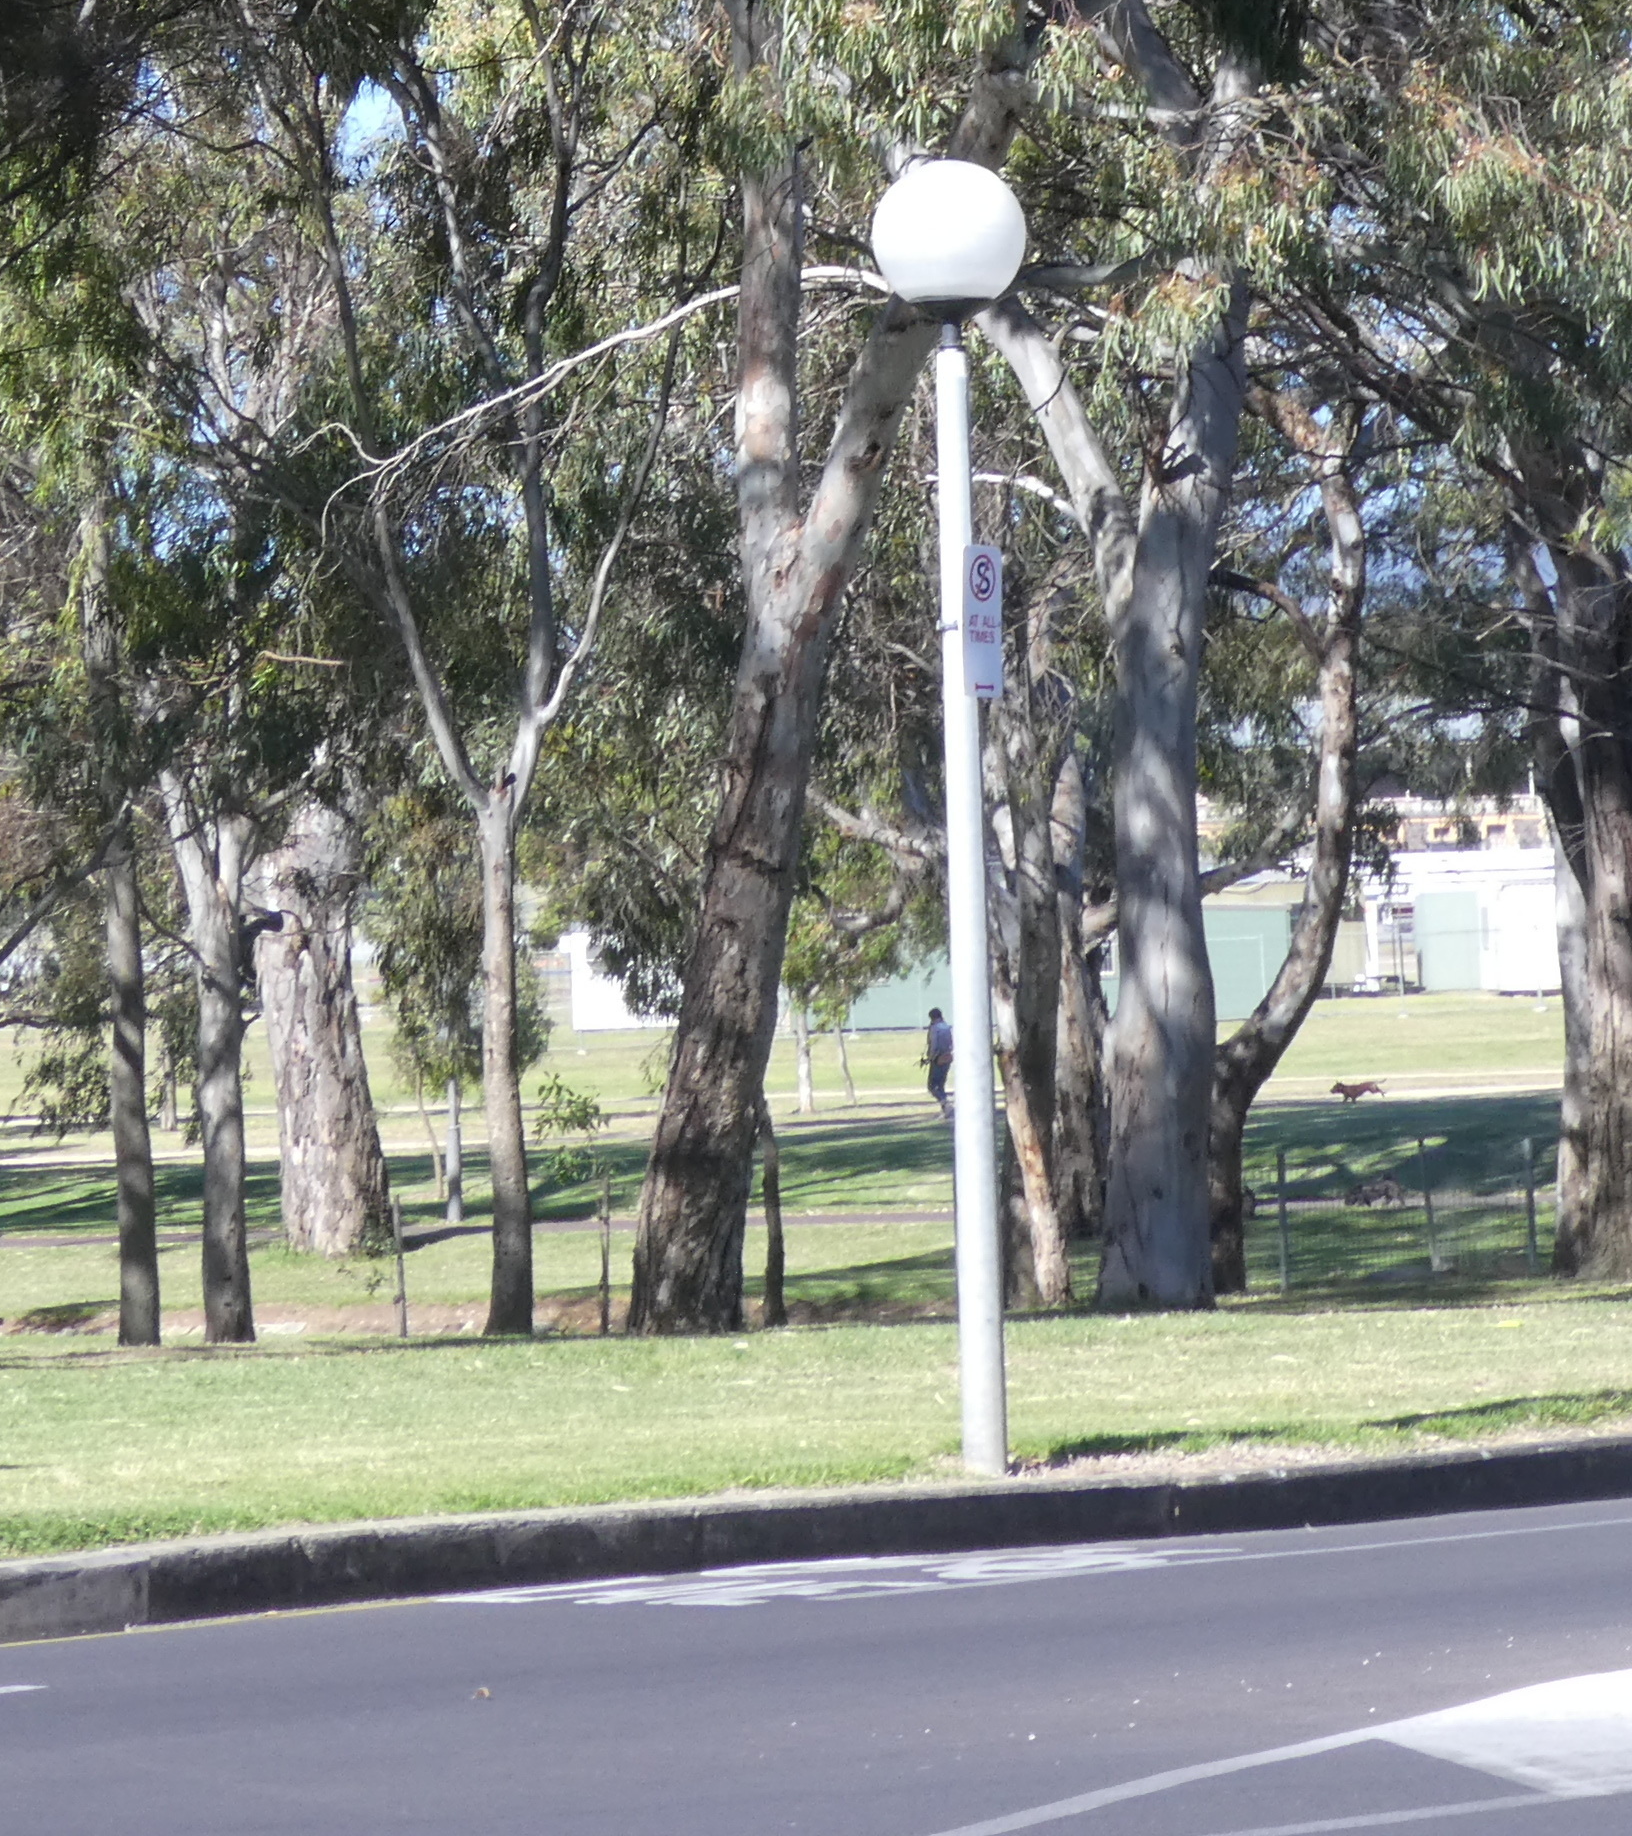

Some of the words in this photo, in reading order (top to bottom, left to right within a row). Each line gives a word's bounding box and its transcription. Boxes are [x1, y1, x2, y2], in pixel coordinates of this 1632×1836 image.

[969, 614, 979, 628] AT
[983, 614, 996, 629] ALL
[969, 630, 996, 644] TIMES
